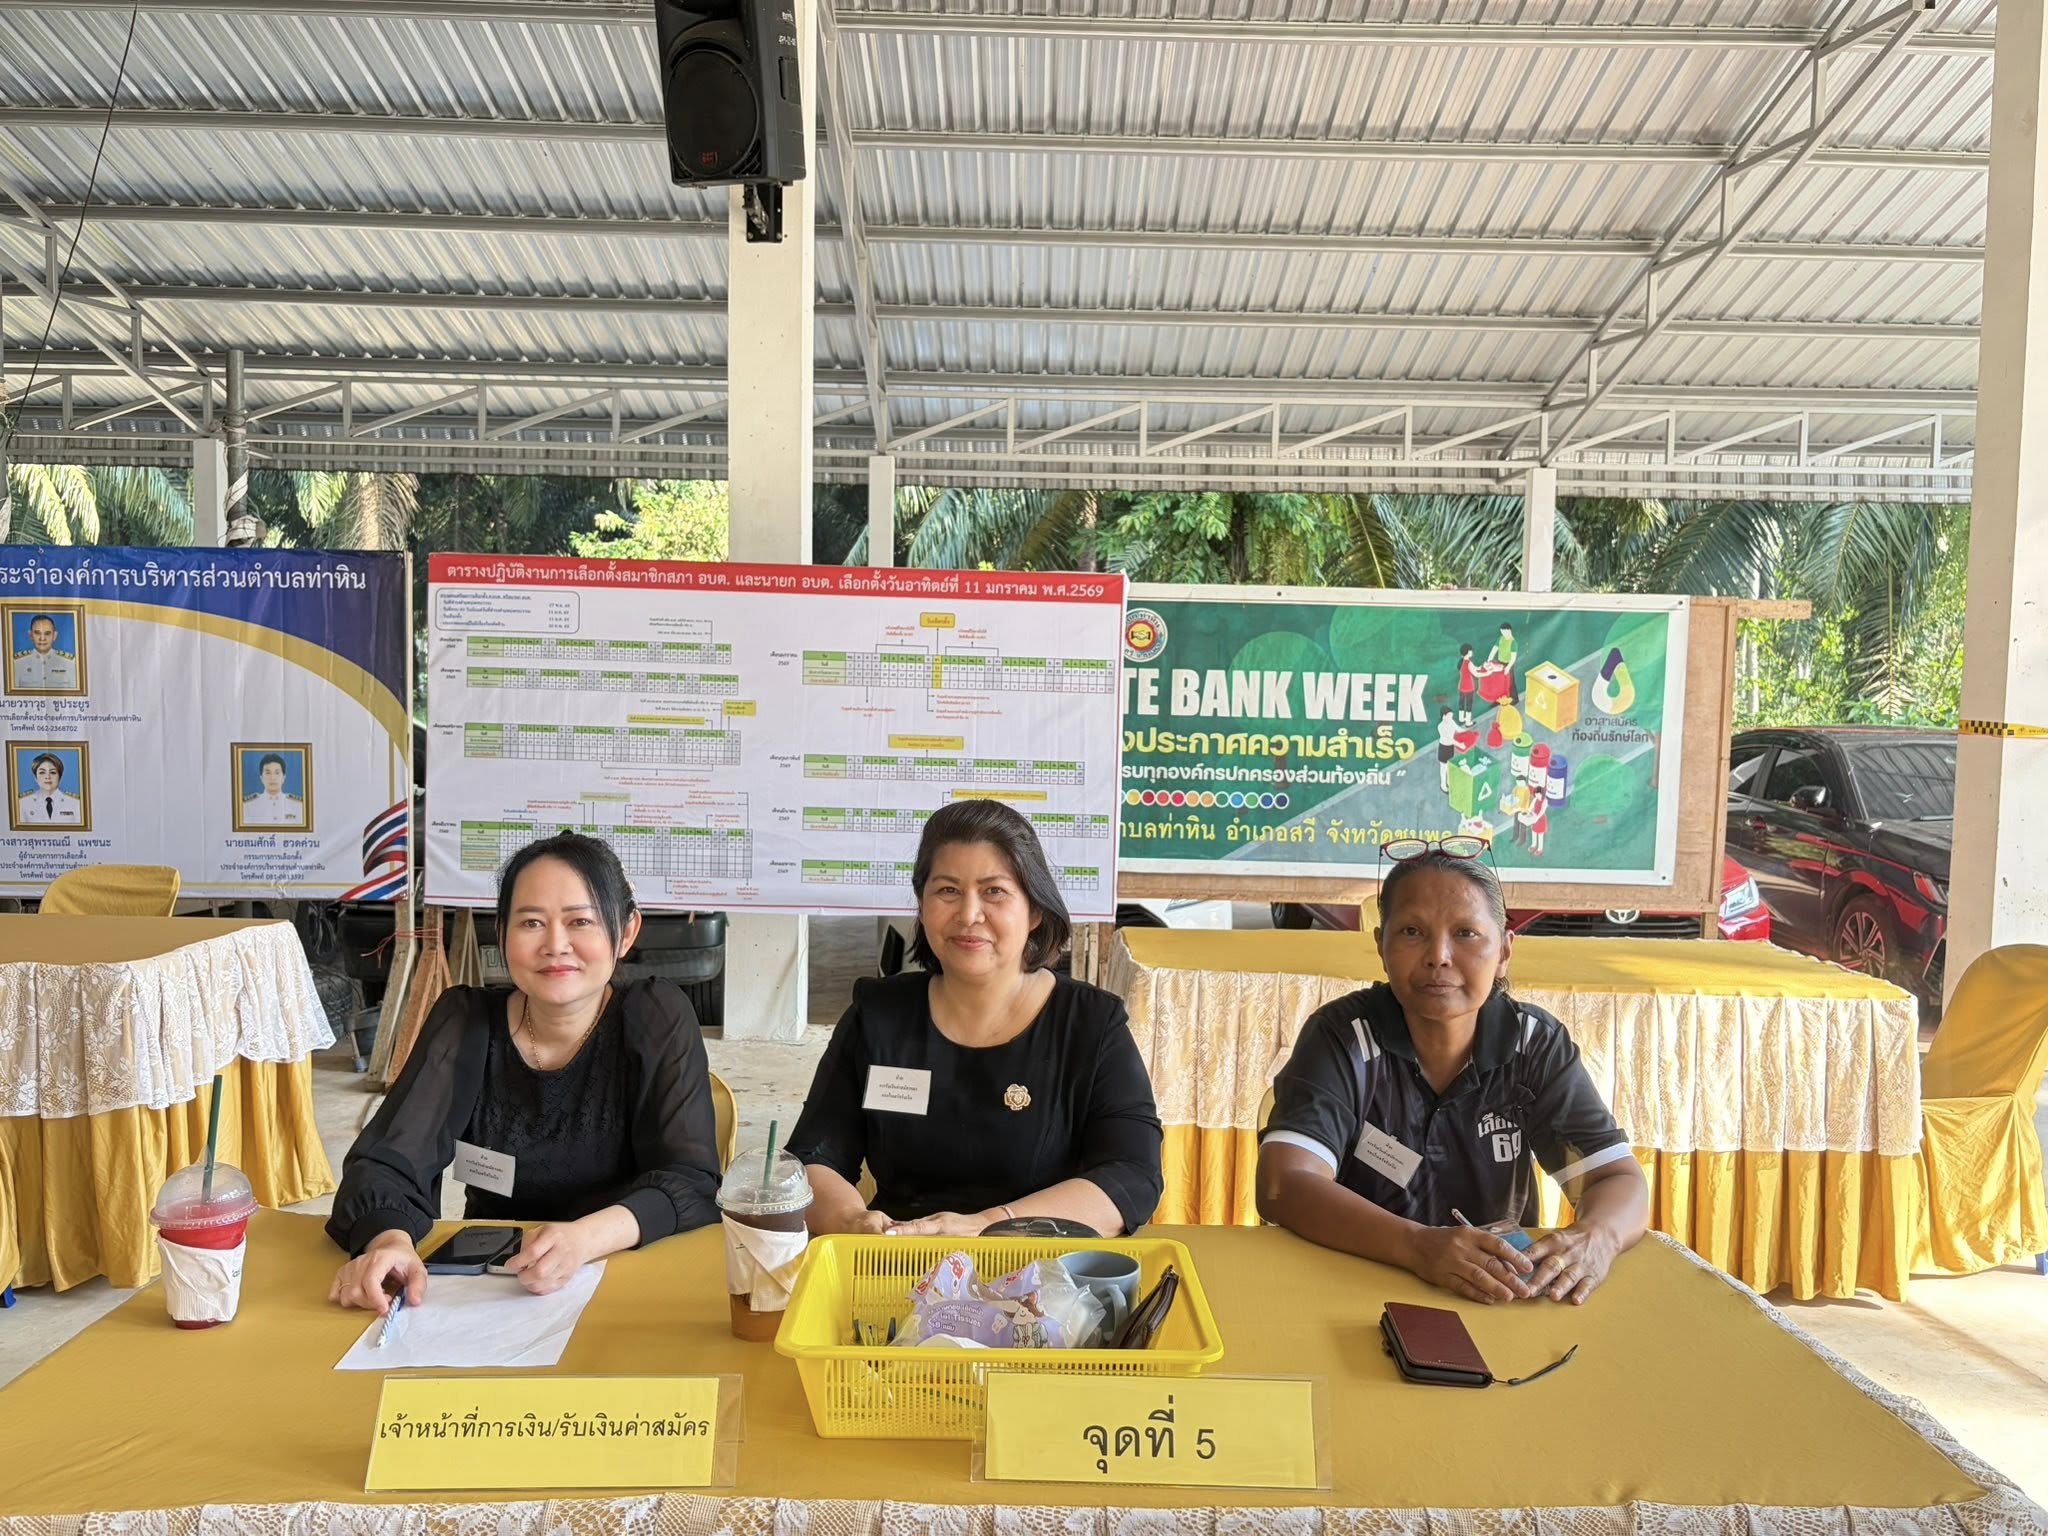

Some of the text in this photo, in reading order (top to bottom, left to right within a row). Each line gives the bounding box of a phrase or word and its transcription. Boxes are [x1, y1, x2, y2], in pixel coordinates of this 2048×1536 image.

[447, 561, 1104, 597] ตารางปฏิบัติงานการเลือกตั้งสมาชิกสภา อบต. และนายก อบต. เลือกตั้งวันอาทิตย์ที่ 11 มกราคม พ.ศ.2569
[1171, 669, 1293, 719] BANK
[1302, 672, 1428, 722] WEEK
[1571, 728, 1649, 742] ท้องถิ่นรักษ์โลก
[1227, 818, 1316, 843] อำเภอสวี
[380, 1406, 709, 1439] เจ้าหน้าที่การเงิน/รับเงินค่าสมัคร
[1083, 1395, 1216, 1474] จุดที่ 5
